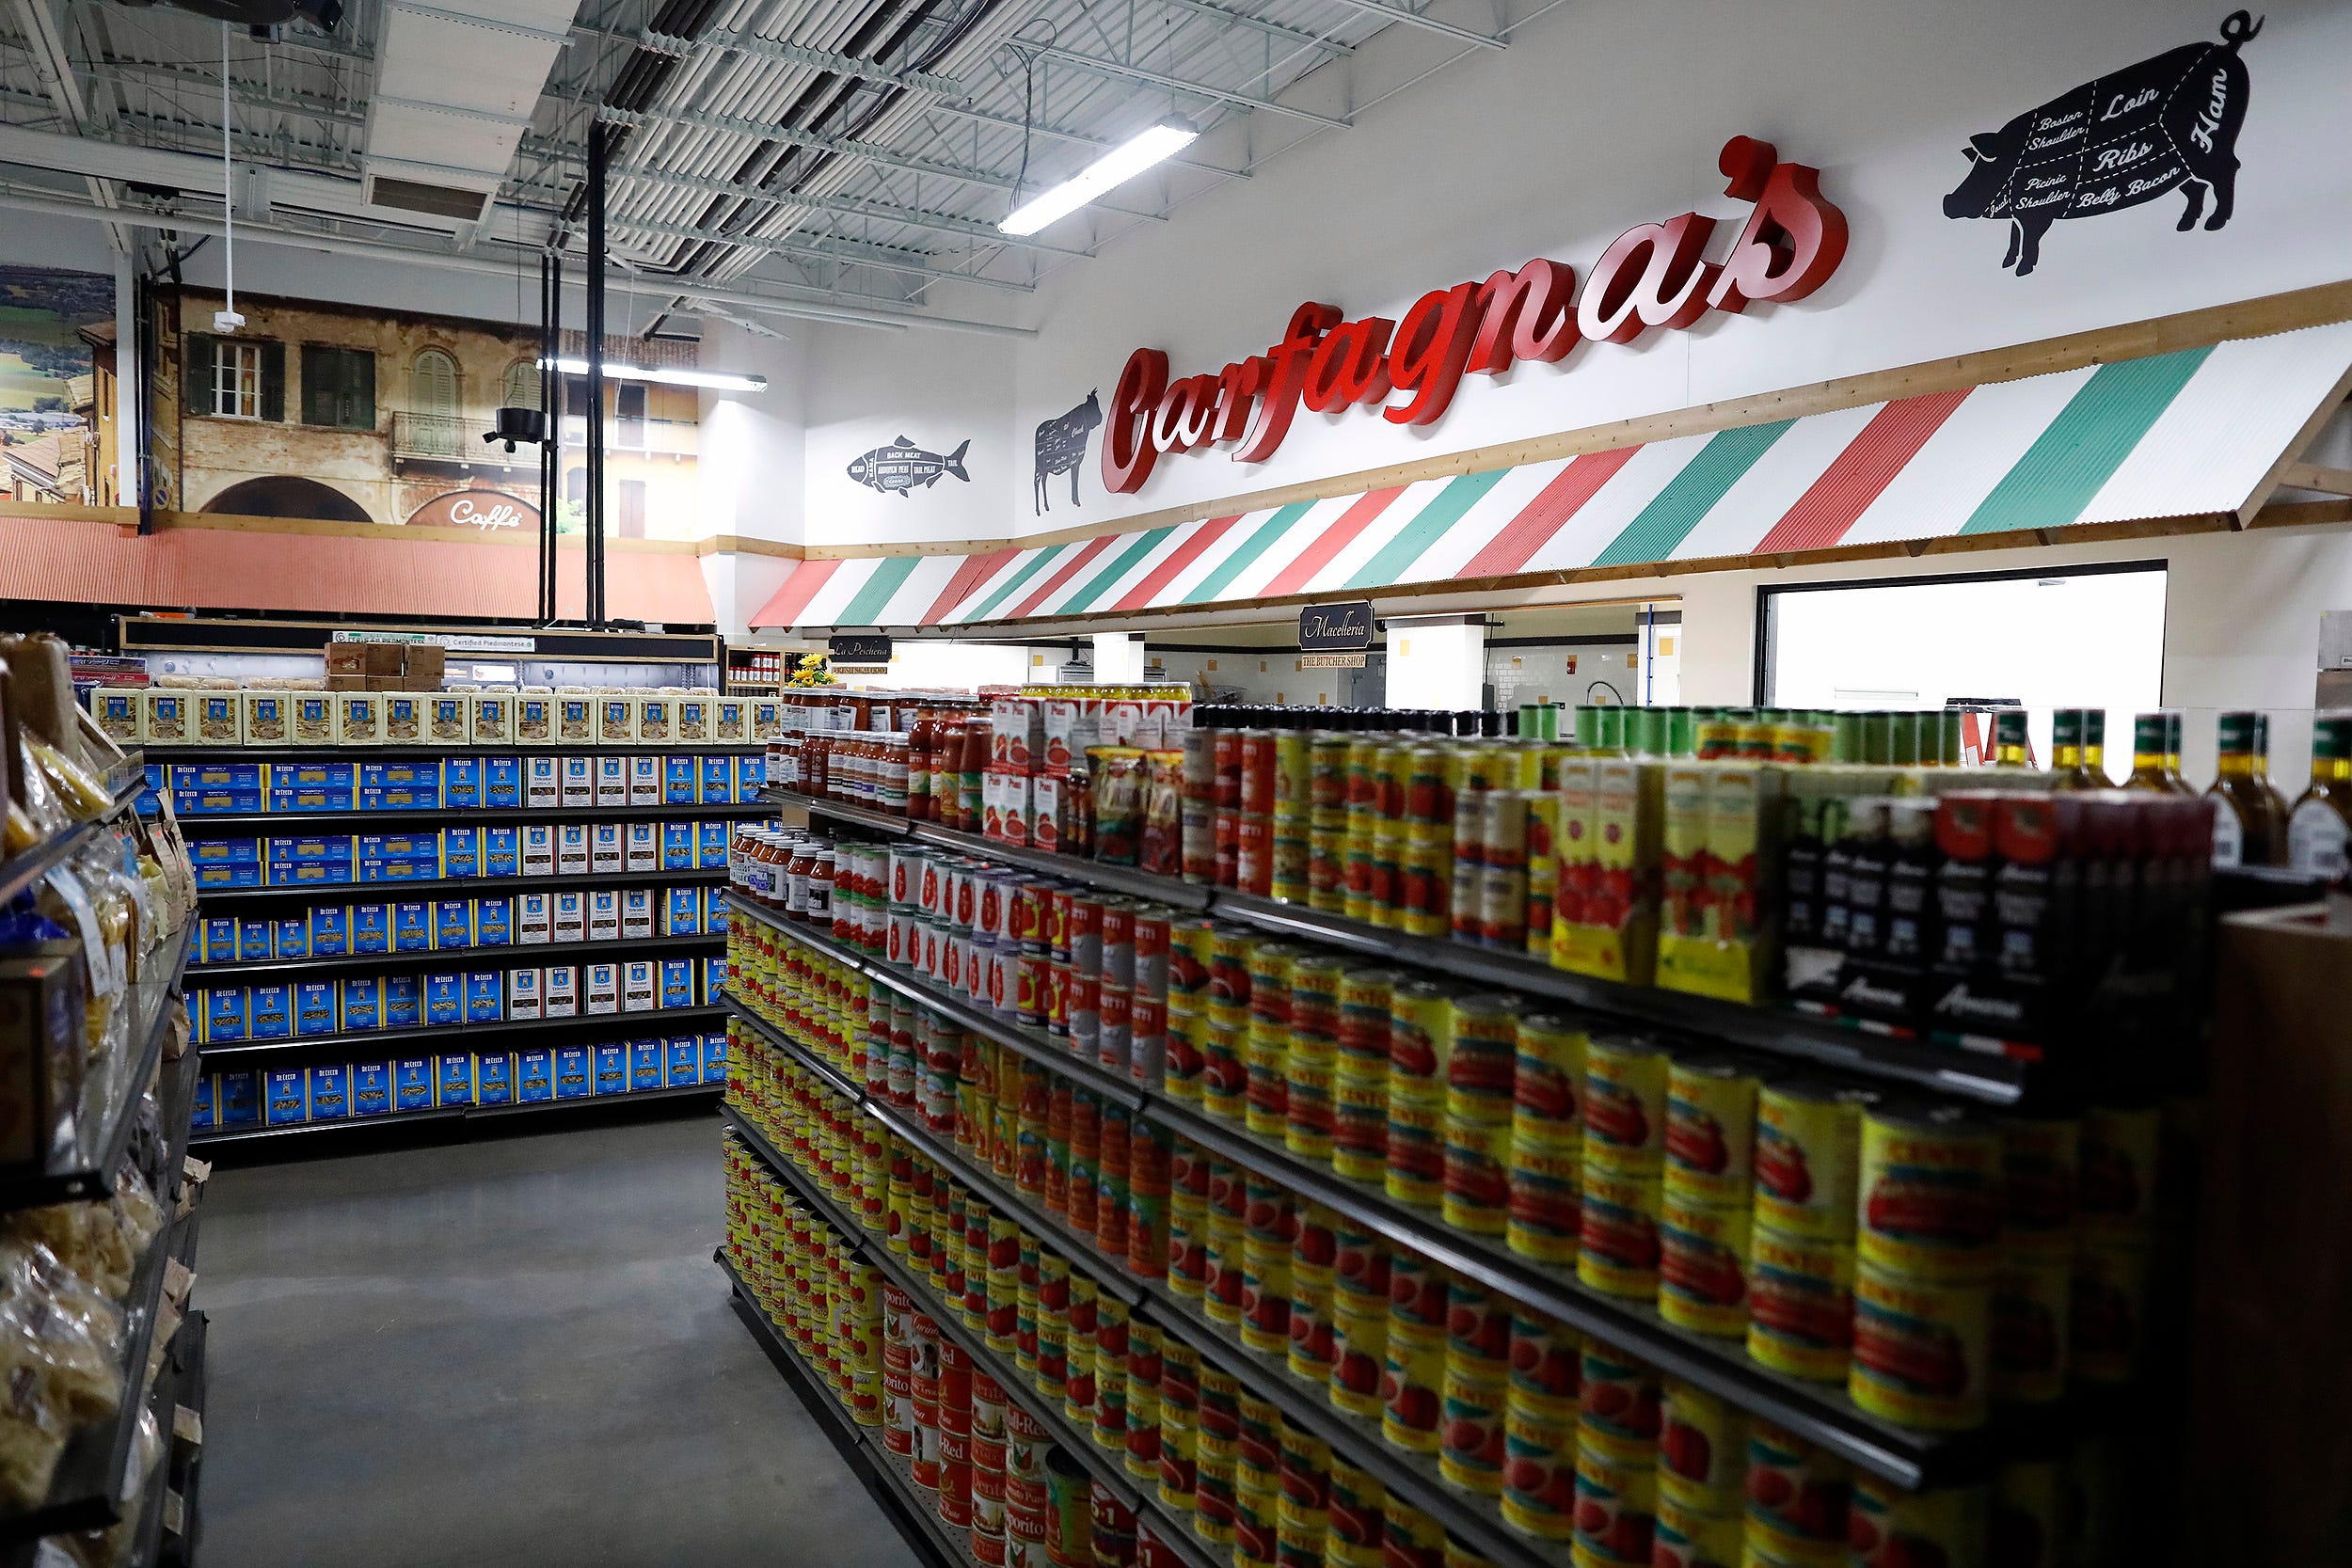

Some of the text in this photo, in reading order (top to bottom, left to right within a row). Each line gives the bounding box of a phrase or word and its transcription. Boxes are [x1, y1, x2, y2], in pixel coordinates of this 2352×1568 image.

[2101, 88, 2159, 121] Loin
[2190, 69, 2228, 154] Ham
[2038, 111, 2083, 132] Boston
[2028, 127, 2085, 150] Shoulder
[2092, 143, 2153, 172] Ribs
[2015, 190, 2071, 210] Shoulder
[2076, 166, 2181, 208] Belly Bacon
[1101, 134, 1849, 495] Carfagna's
[451, 499, 523, 531] Caffè
[1305, 610, 1365, 638] Macelleria
[1303, 656, 1365, 667] THE BUTCHER SHOP
